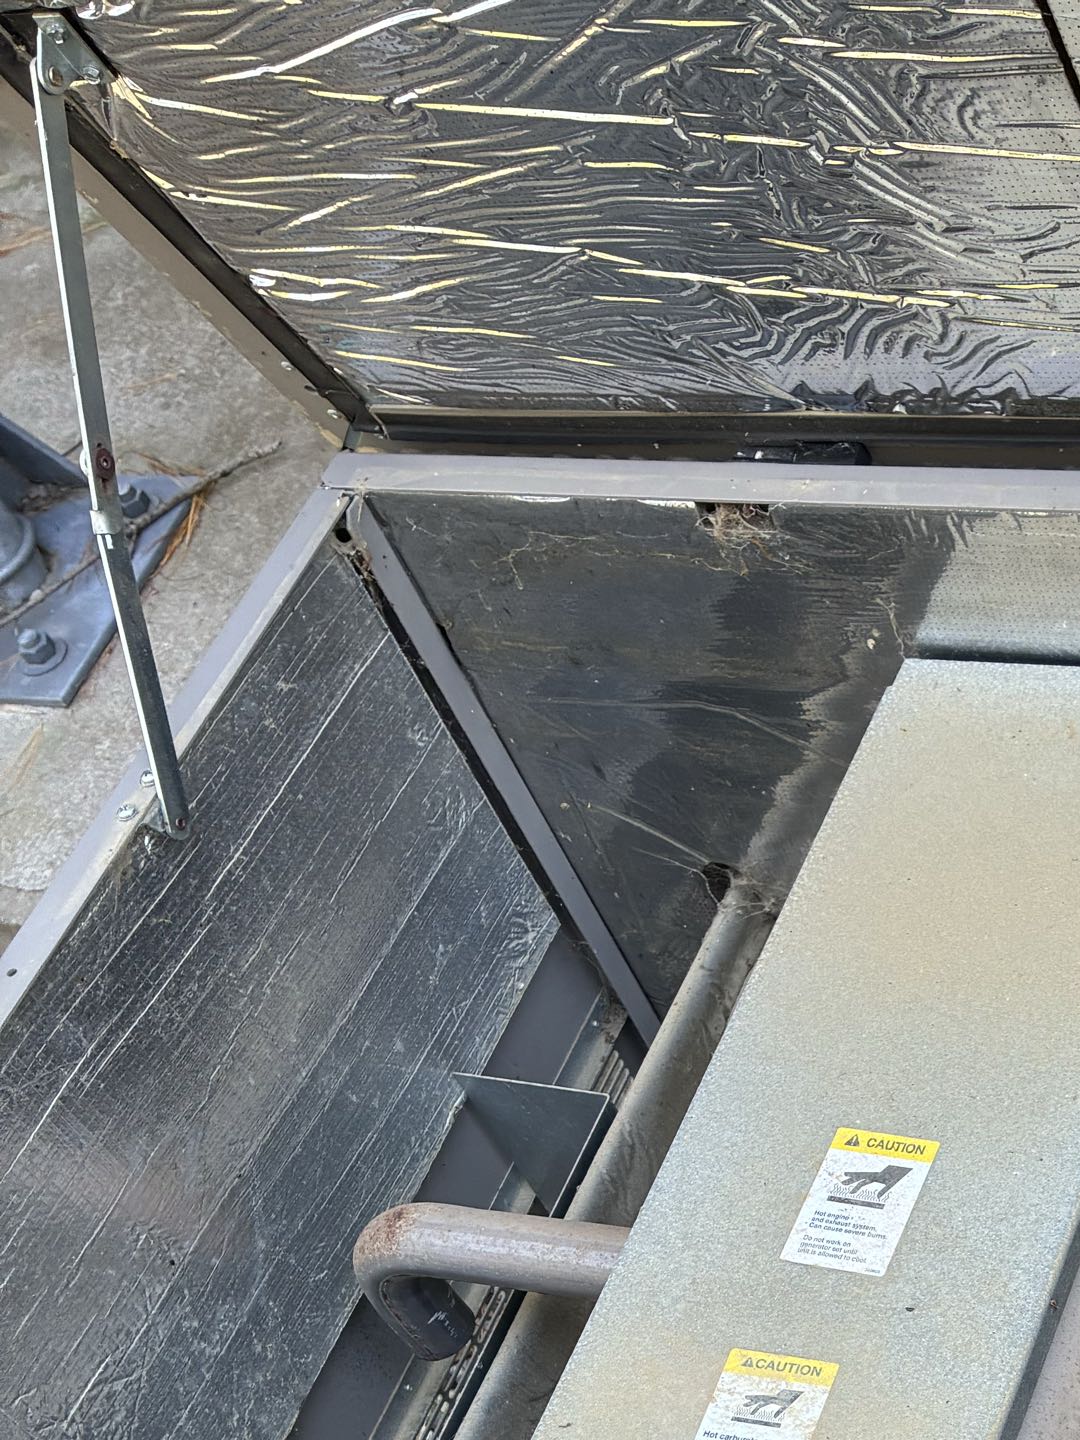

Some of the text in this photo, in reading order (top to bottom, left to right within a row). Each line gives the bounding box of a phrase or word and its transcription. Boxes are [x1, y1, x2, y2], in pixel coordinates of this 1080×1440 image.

[865, 1137, 927, 1155] CAUTION
[826, 1213, 850, 1221] engine
[824, 1218, 851, 1227] exhaust
[817, 1250, 843, 1260] allowed
[754, 1358, 822, 1377] CAUTION
[702, 1430, 719, 1439] Hot
